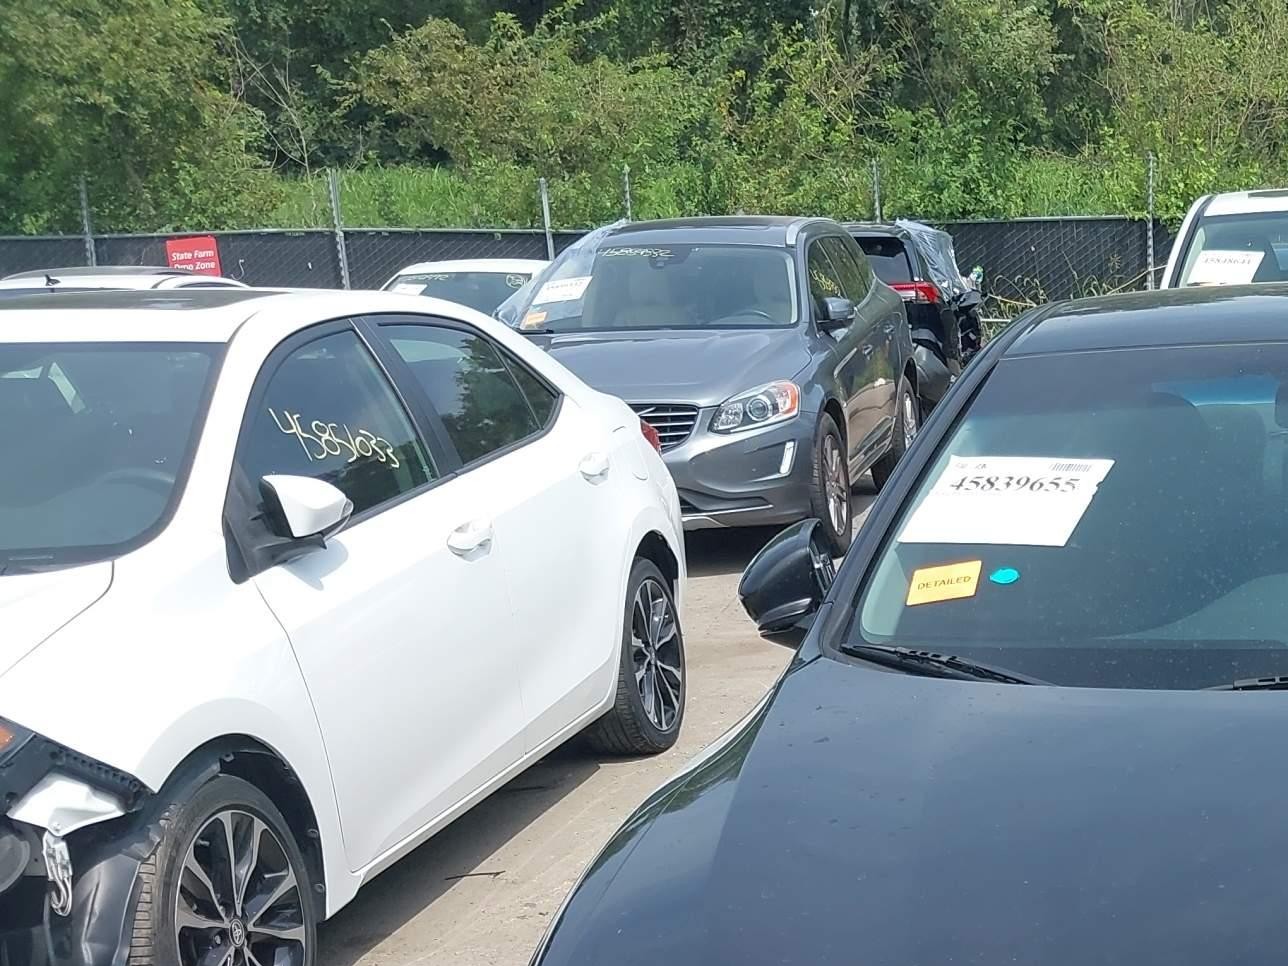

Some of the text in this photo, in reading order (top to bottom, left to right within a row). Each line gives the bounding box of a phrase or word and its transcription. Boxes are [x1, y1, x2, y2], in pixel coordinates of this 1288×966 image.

[171, 249, 215, 262] State Farm
[195, 261, 216, 270] Zone
[268, 407, 400, 468] 45851033
[950, 475, 1081, 493] 45839655
[917, 575, 972, 591] DETAILED
